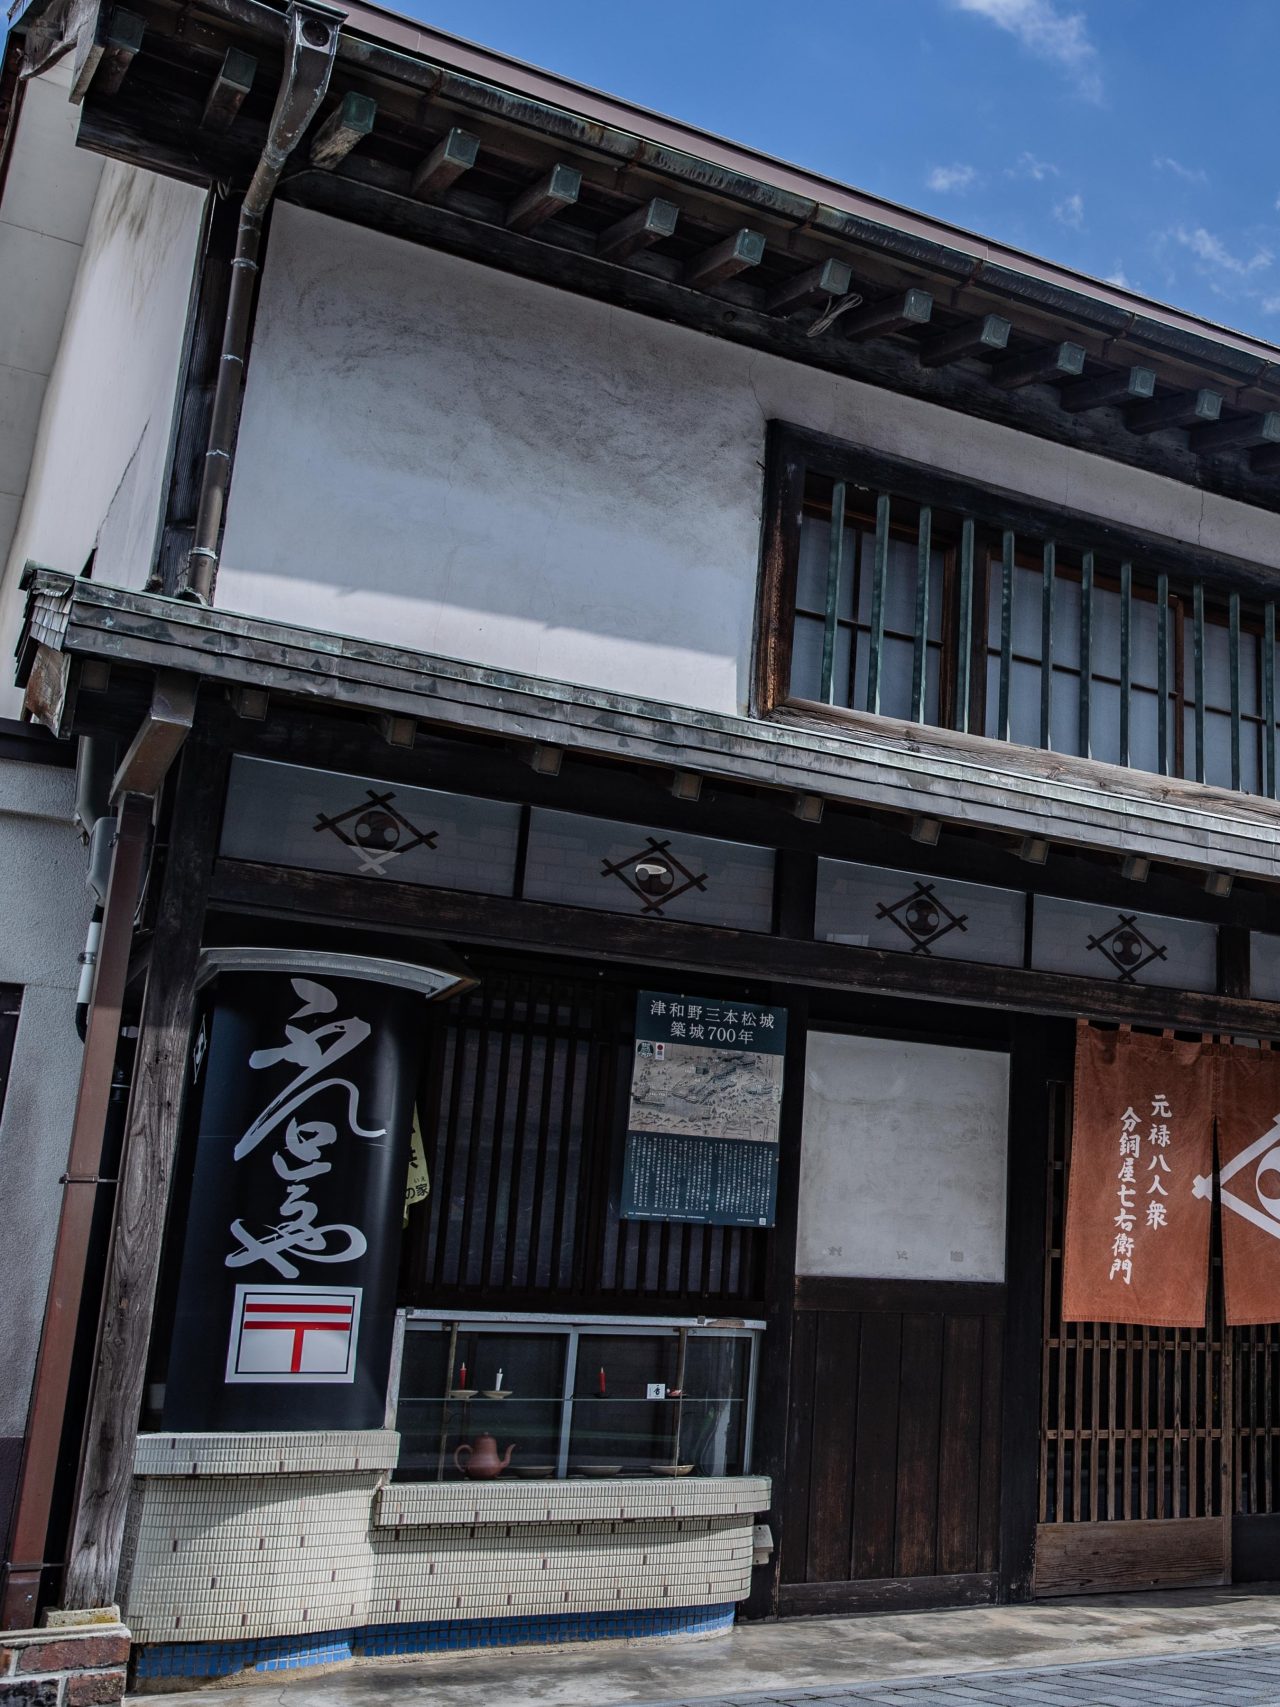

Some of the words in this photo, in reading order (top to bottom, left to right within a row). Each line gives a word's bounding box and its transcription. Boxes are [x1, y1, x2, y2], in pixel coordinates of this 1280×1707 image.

[650, 1000, 775, 1029] 津和野三本松城
[670, 1021, 754, 1045] 築城700年
[1109, 1106, 1142, 1285] 分銅屋七右衛門
[1145, 1094, 1173, 1230] 元禄八人衆
